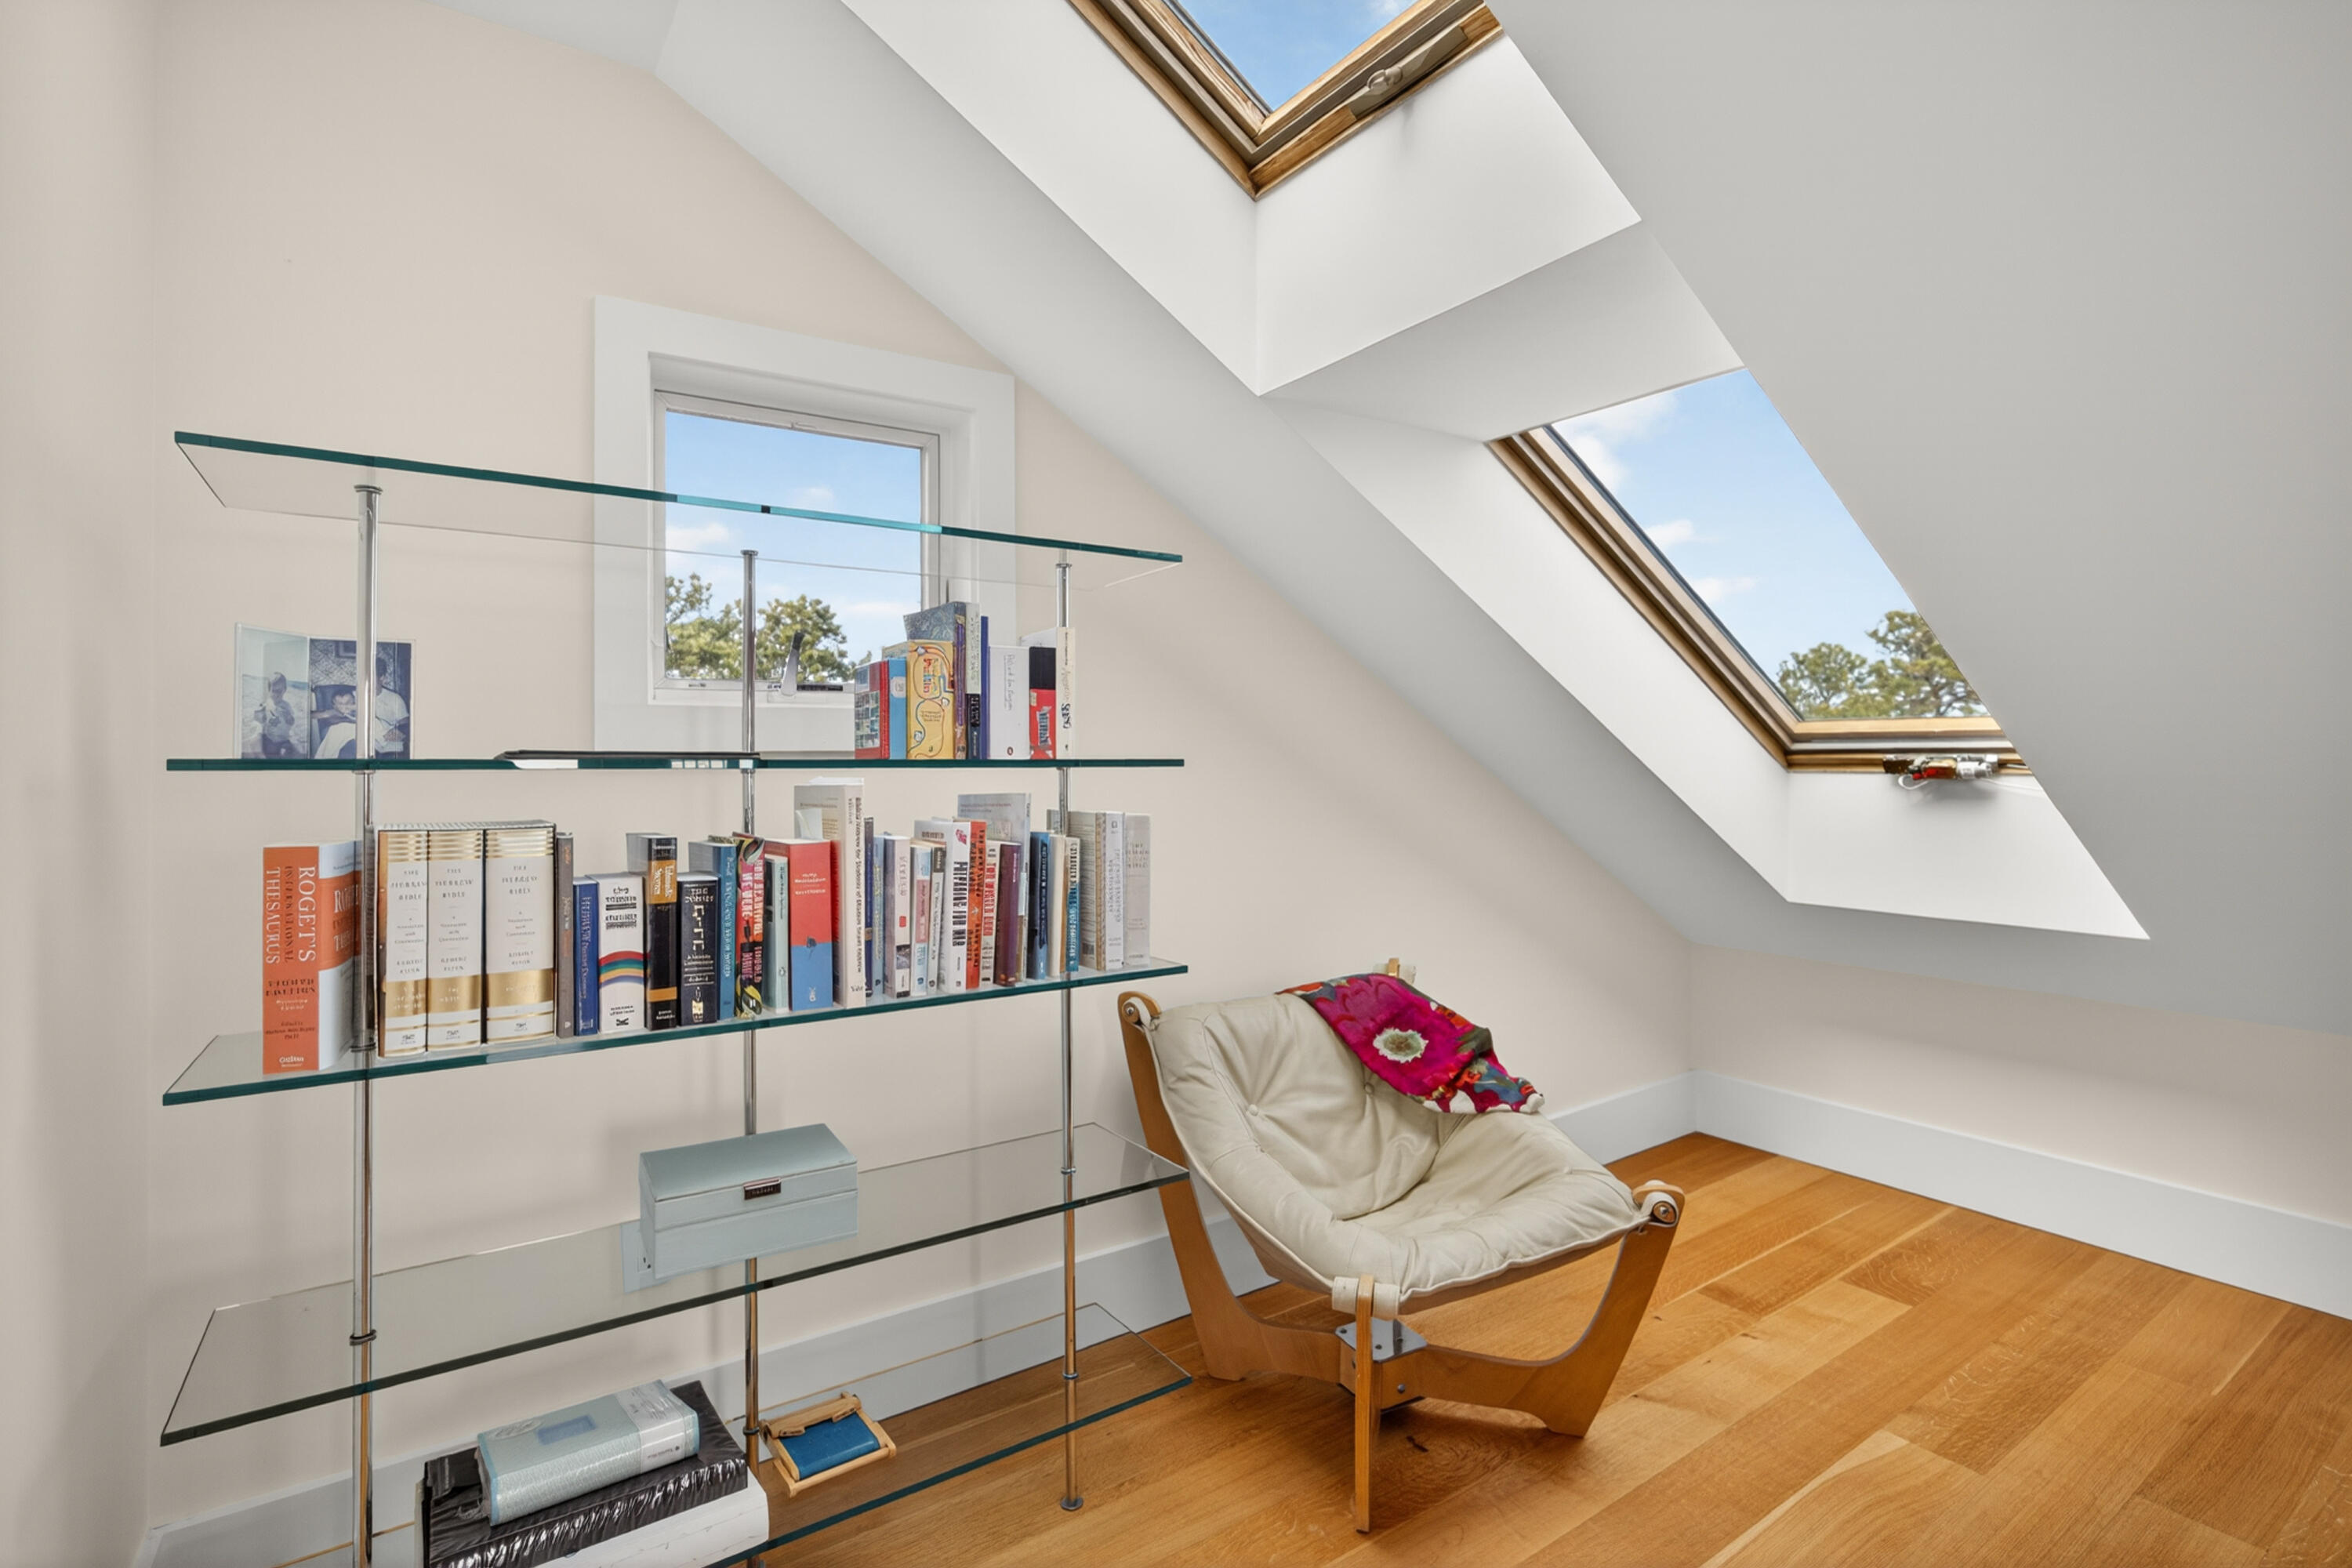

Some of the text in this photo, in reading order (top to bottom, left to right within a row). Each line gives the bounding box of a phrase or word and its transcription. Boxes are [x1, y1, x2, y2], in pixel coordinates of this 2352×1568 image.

[266, 866, 281, 964] THESAURUS
[285, 866, 294, 964] INTERNATIONAL
[298, 866, 316, 962] ROGET'S
